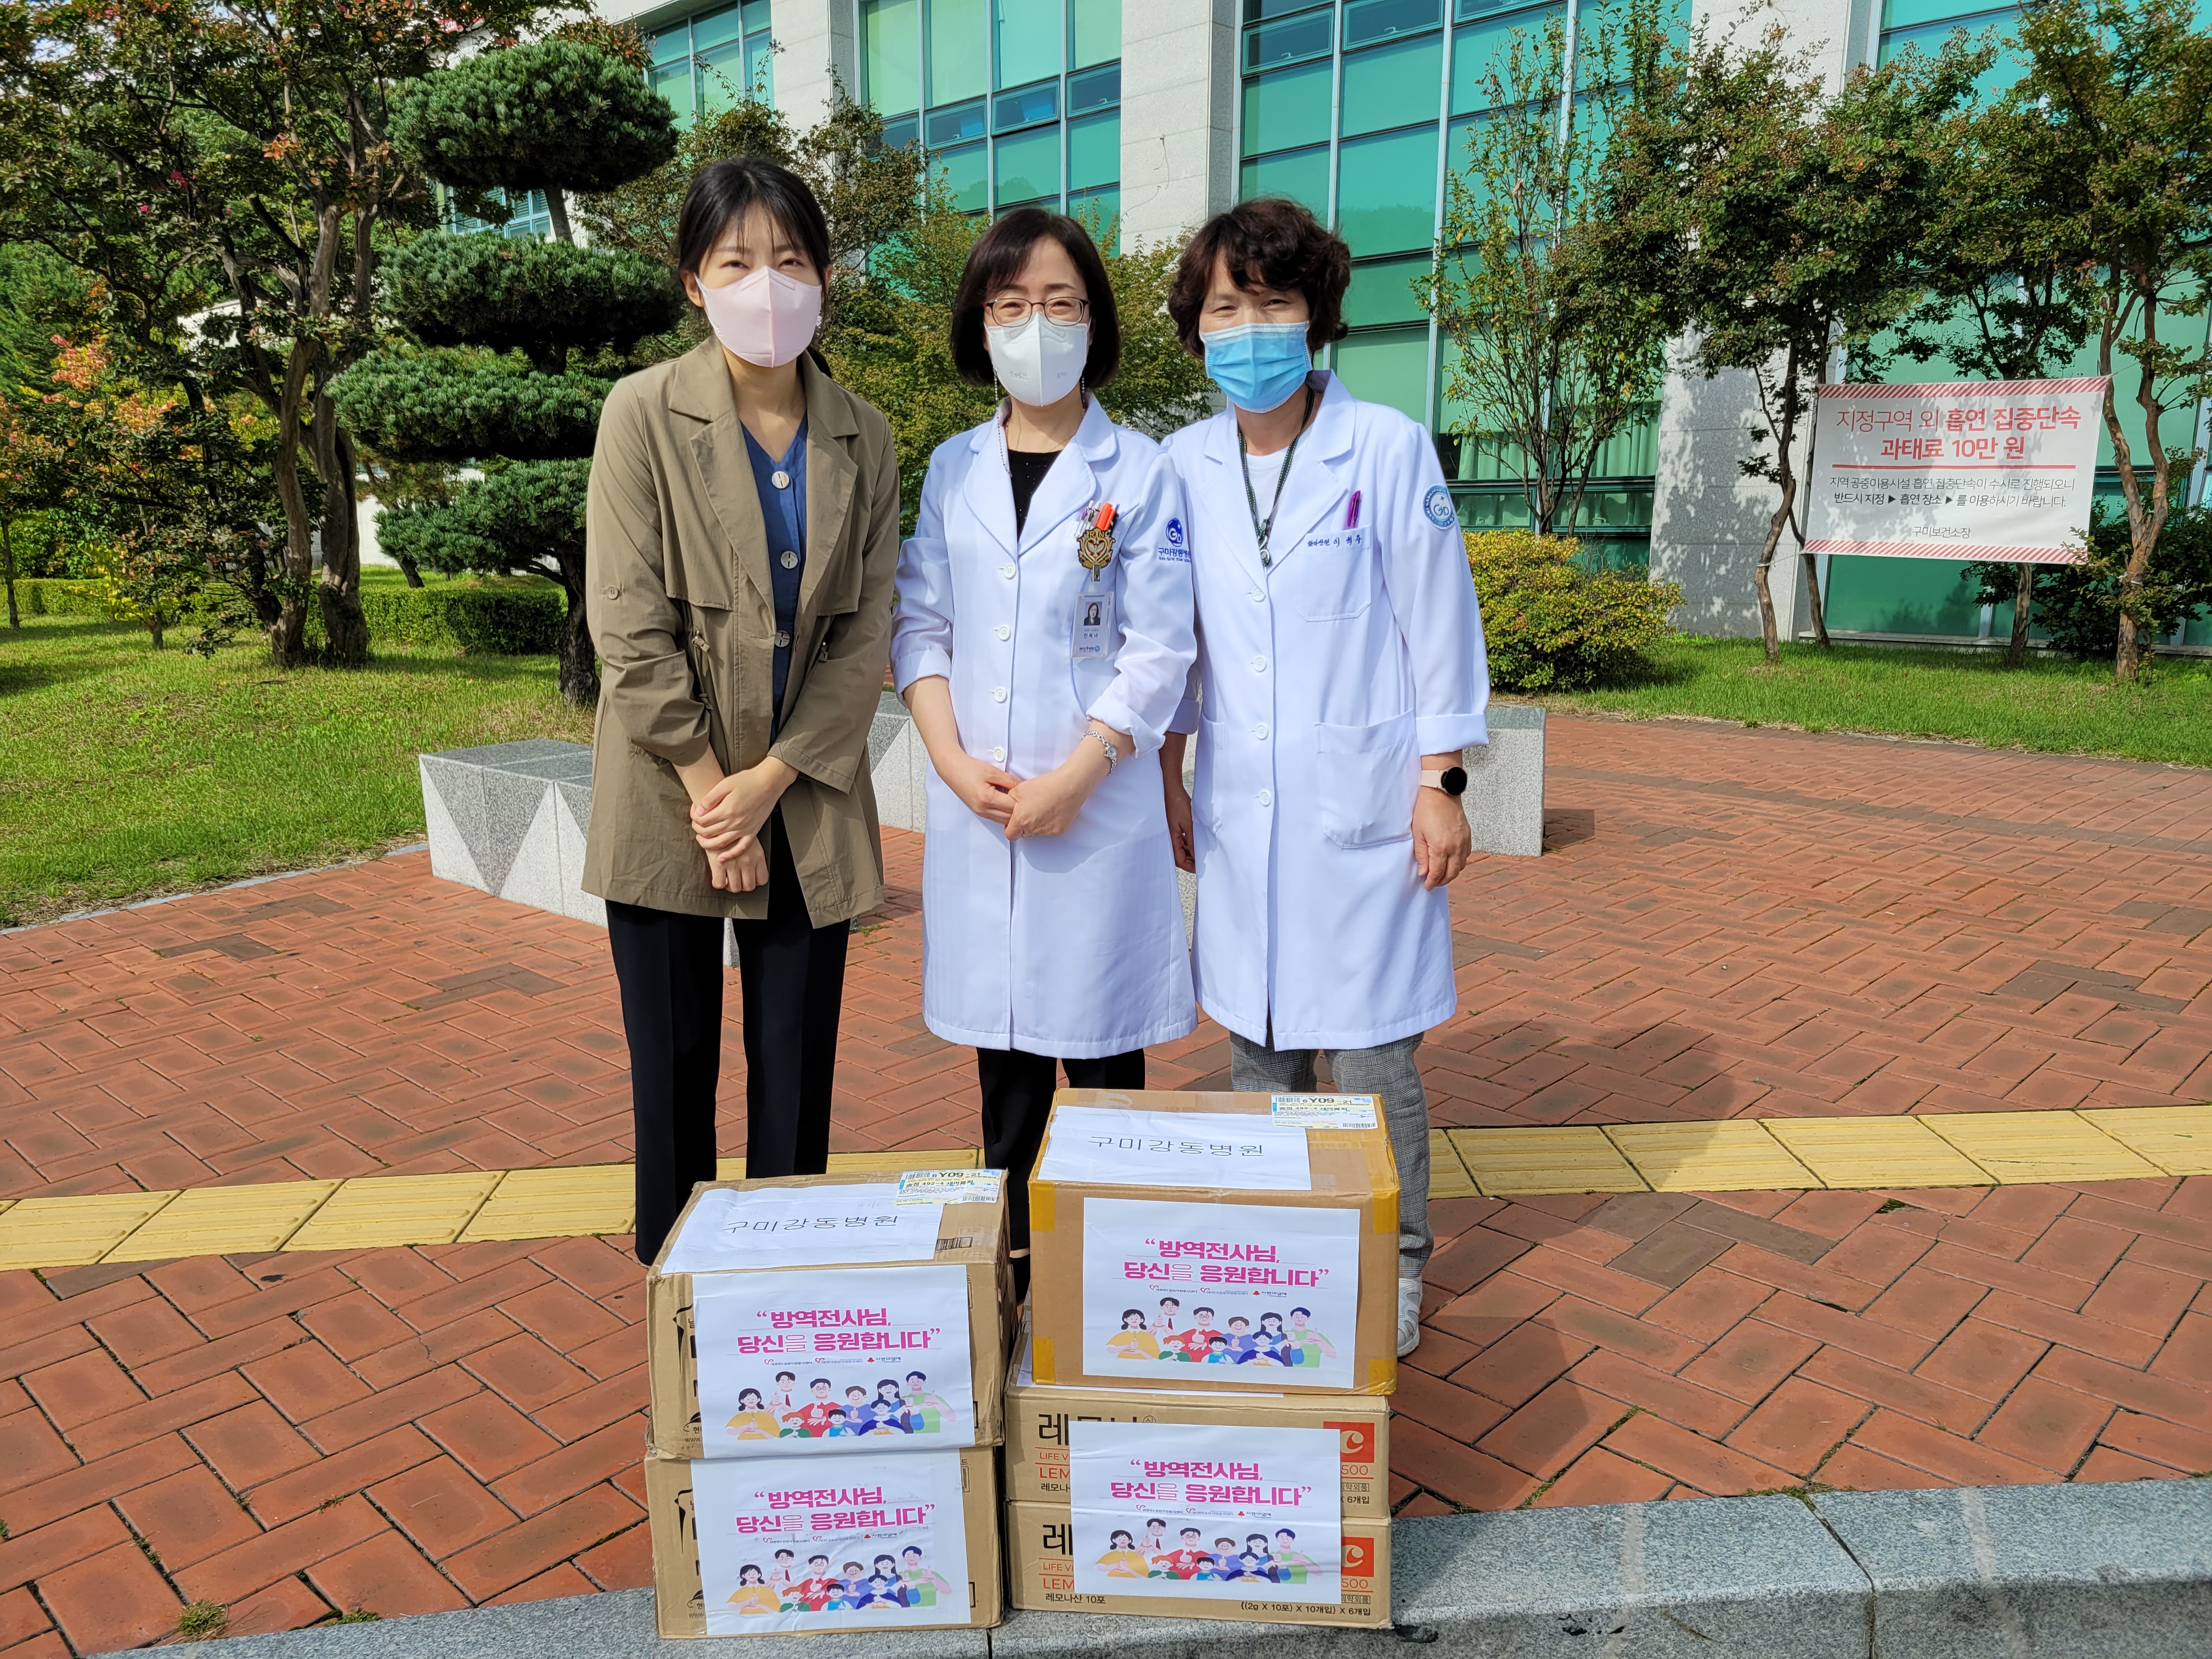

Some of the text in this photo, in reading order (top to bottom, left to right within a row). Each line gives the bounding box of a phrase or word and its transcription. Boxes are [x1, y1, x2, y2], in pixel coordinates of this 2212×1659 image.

[1836, 405, 2082, 433] 지정구역 외 흡연 집중단속
[1880, 436, 2025, 461] 과태료 10만 원
[1850, 477, 1910, 489] 공중이용시설
[1912, 477, 1933, 489] 흡연
[1935, 477, 1987, 490] 집중단속이
[1989, 478, 2021, 490] 수시로
[2022, 478, 2075, 491] 진행되오니
[1833, 492, 2067, 508] 반드시 지정 흡연 장소 를 이용하시기 바랍니다.
[1911, 526, 1972, 539] 구미보건소장
[1088, 1136, 1264, 1157] 구미강동병원
[723, 1215, 898, 1234] 구미강동병원
[1124, 1261, 1194, 1281] 당신을
[737, 1334, 808, 1354] 당신을
[1039, 1452, 1060, 1460] LIFE
[1341, 1465, 1369, 1476] 500
[1110, 1482, 1179, 1501] 당신을
[1347, 1496, 1370, 1504] 6개입
[735, 1514, 805, 1534] 당신을
[1042, 1562, 1063, 1571] LIFE
[1043, 1578, 1075, 1590] LEM
[1341, 1578, 1369, 1589] 500
[1045, 1593, 1107, 1605] 레모나산 10포
[1271, 1604, 1293, 1612] 10포)
[1348, 1607, 1371, 1616] 6개입
